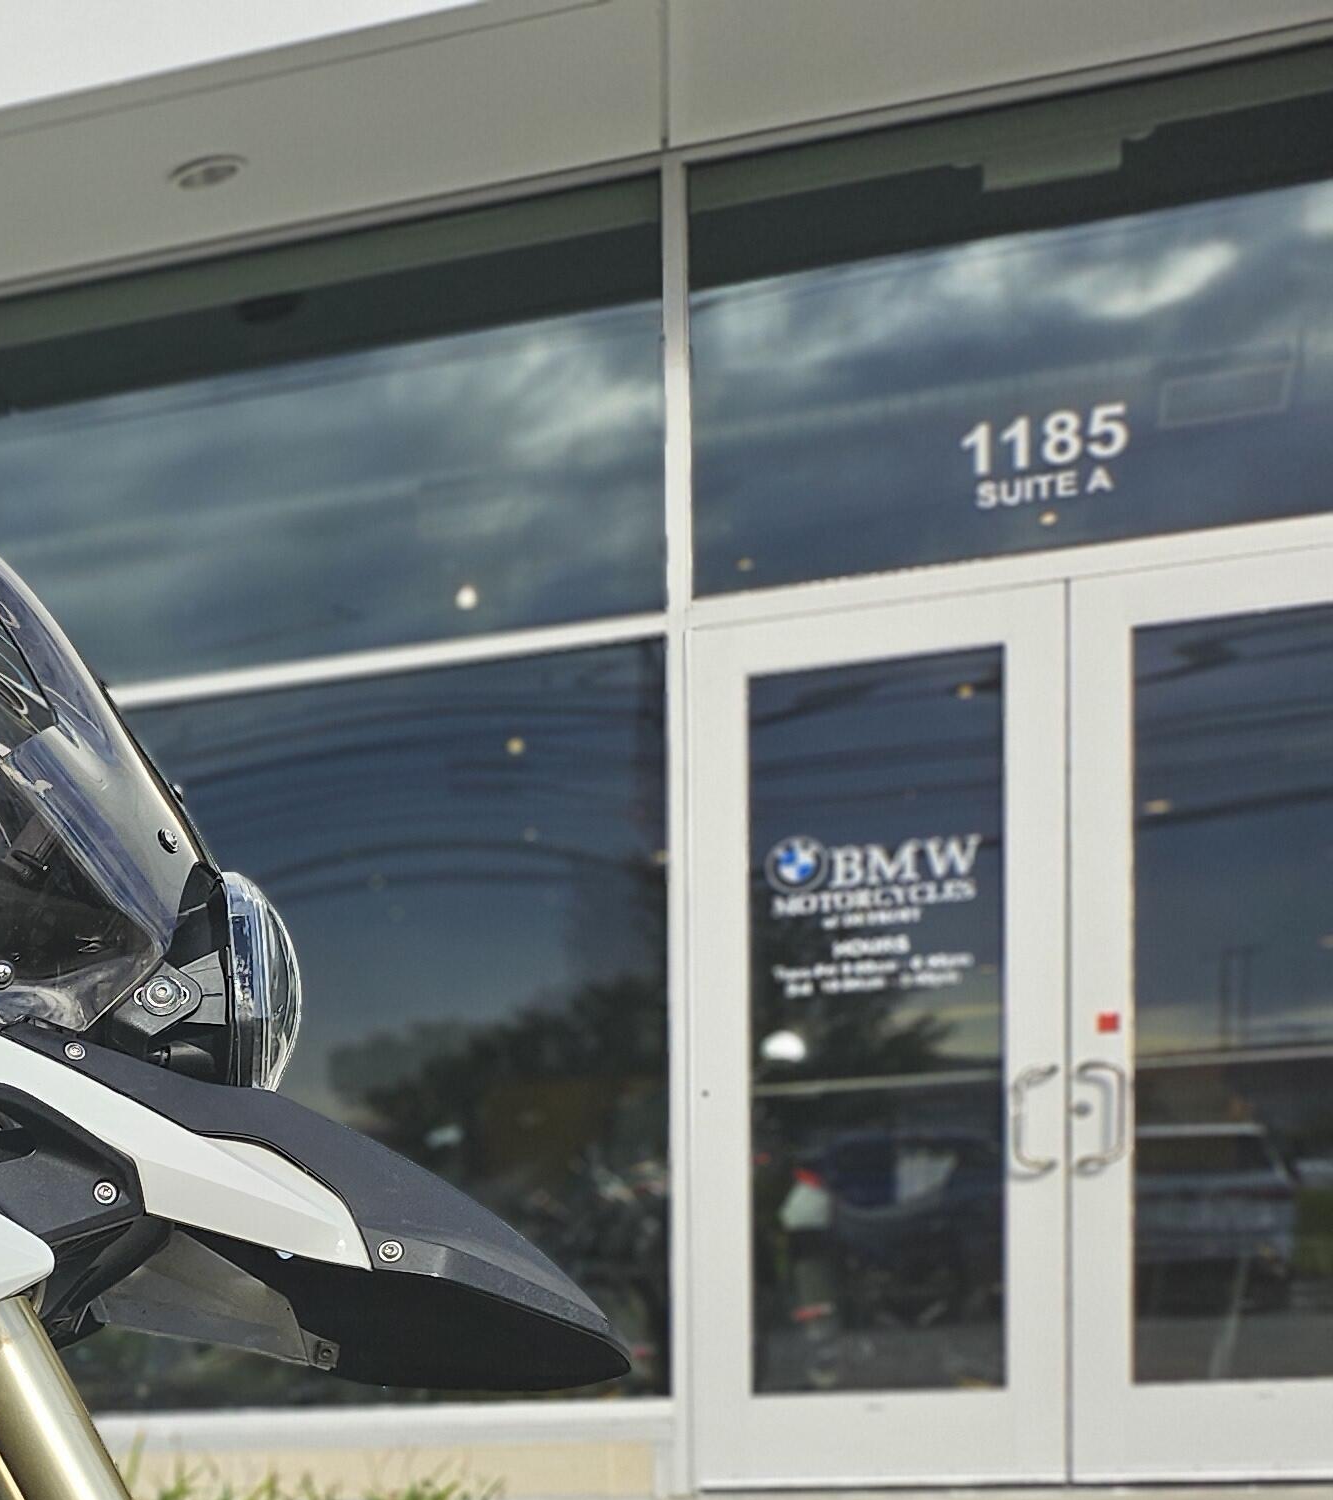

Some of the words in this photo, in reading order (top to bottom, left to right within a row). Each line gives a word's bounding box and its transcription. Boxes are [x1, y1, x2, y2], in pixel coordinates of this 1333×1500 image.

[960, 401, 1130, 476] 1185
[975, 471, 1079, 510] SUITE
[1087, 466, 1114, 493] A
[829, 833, 982, 889] BMW
[771, 879, 976, 917] MOTORCYCLES
